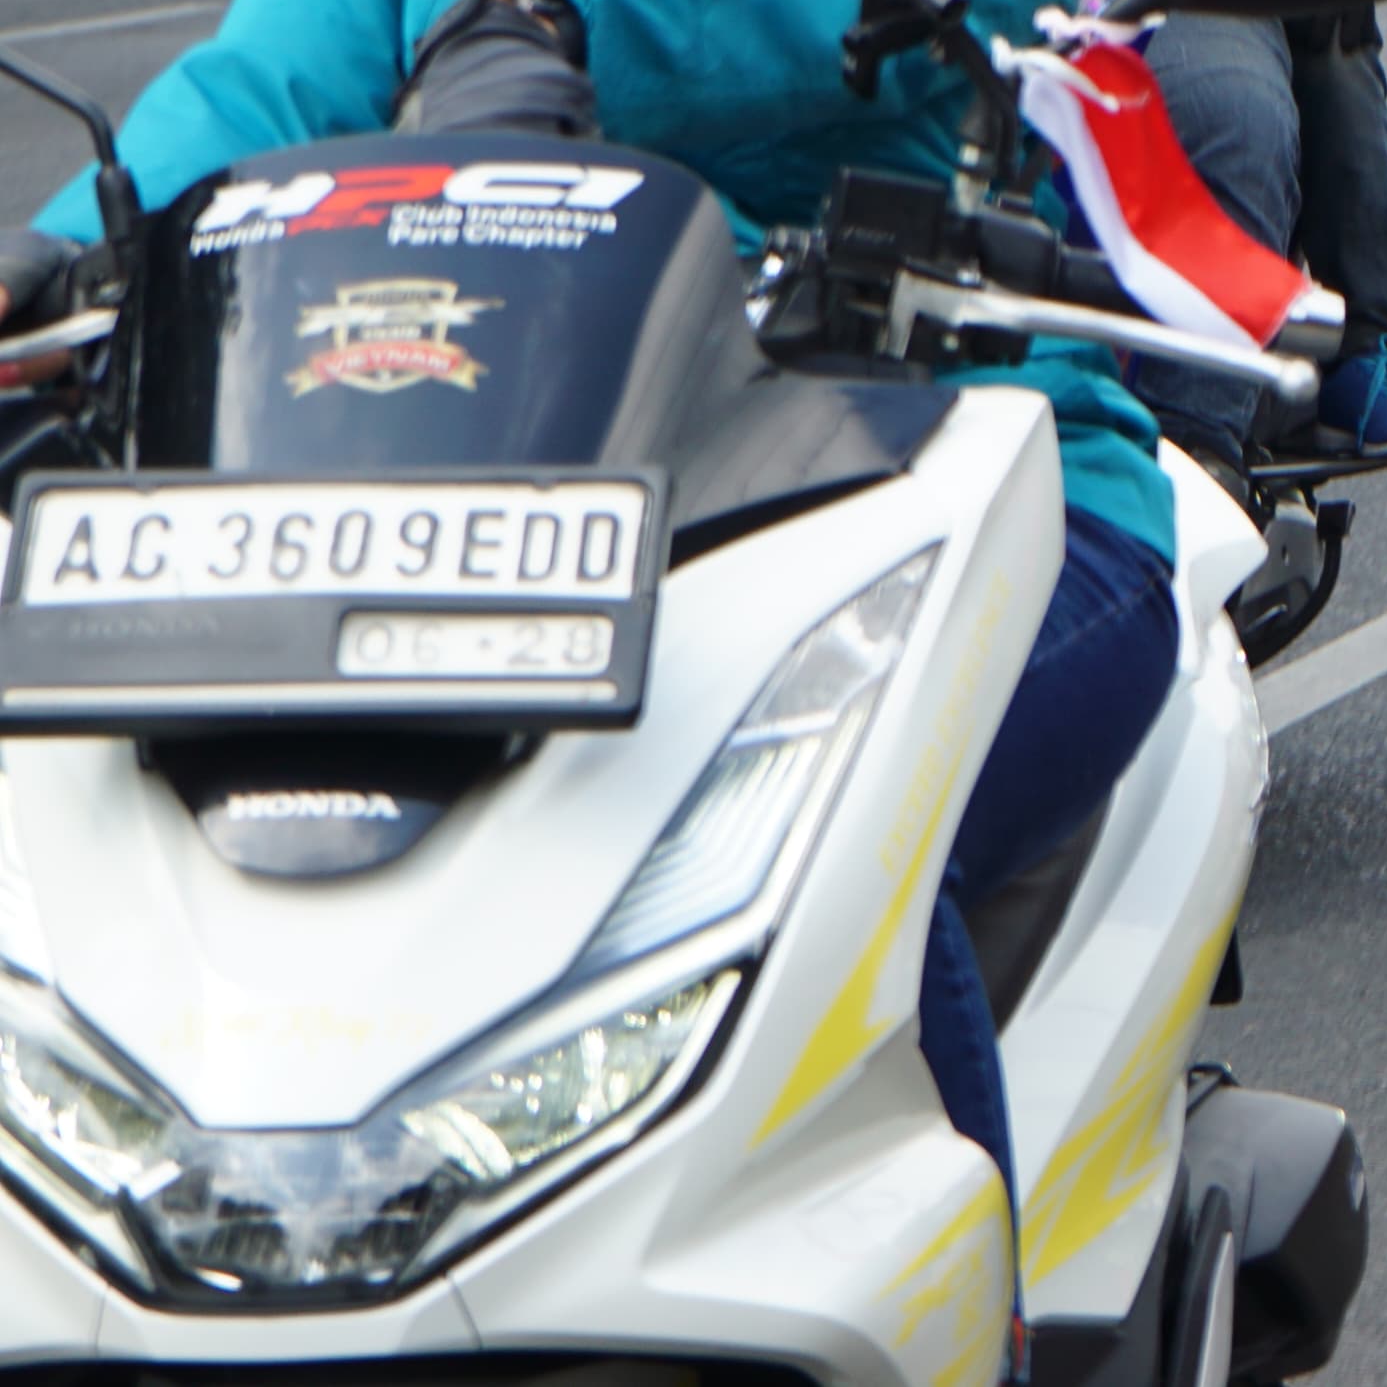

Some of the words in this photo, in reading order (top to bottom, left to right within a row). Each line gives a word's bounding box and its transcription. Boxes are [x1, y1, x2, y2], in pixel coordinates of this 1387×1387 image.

[189, 218, 286, 256] Honda
[390, 202, 463, 227] Club
[465, 203, 617, 234] Indonesia
[387, 222, 460, 247] Pare
[463, 222, 590, 250] Chapter
[54, 513, 172, 584] AG
[228, 789, 402, 822] HONDA
